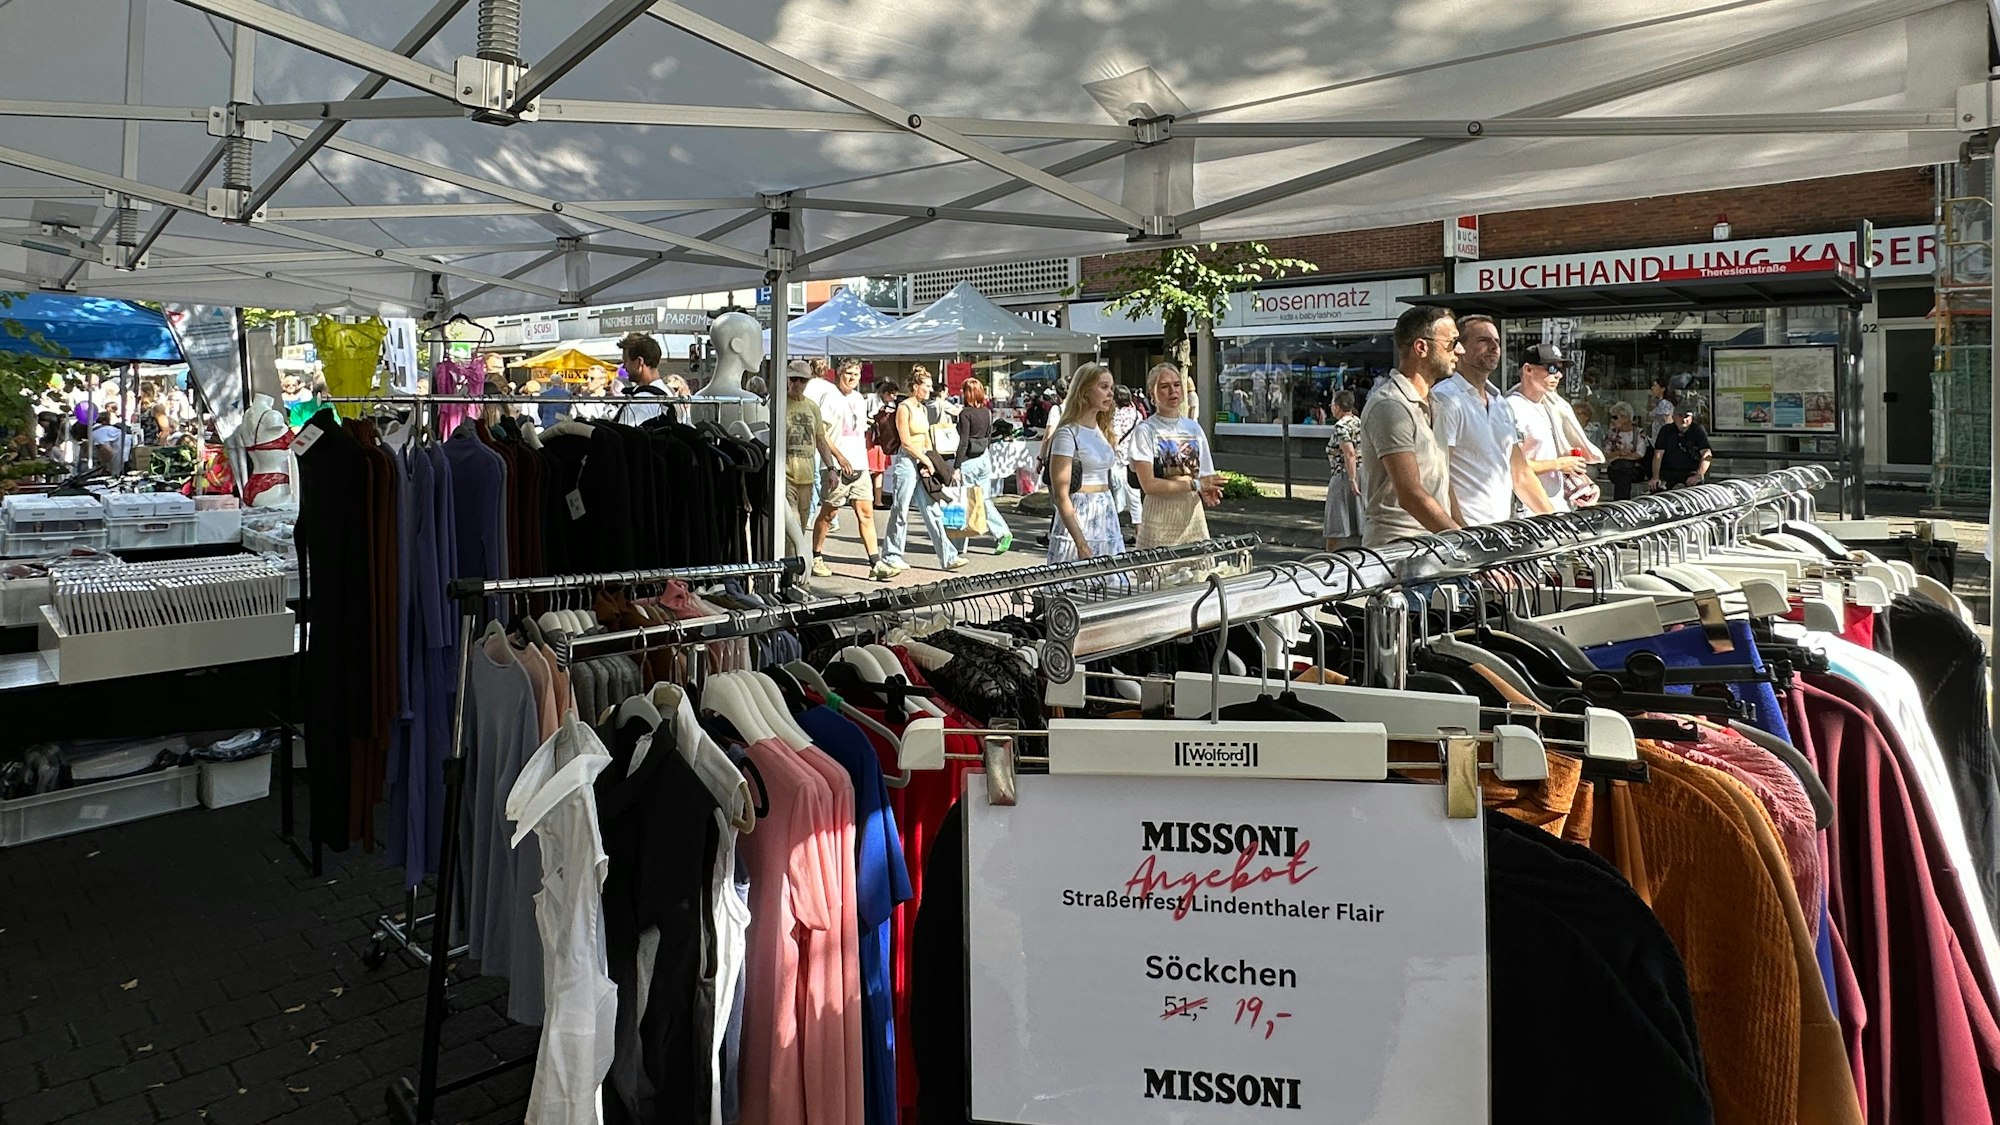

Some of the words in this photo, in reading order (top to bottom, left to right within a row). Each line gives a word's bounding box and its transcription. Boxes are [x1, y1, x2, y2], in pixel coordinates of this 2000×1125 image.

[1457, 229, 1478, 243] BUCH
[1457, 243, 1478, 255] KAISER
[1479, 247, 1770, 291] BUCHHANDLUNG
[1700, 264, 1787, 277] Theresienstraße
[1254, 287, 1370, 312] hosenmatz
[533, 323, 552, 334] SCUSI
[1014, 309, 1057, 328] ILS
[1188, 748, 1244, 761] Wolford
[1142, 821, 1298, 857] MISSONI
[1124, 840, 1319, 921] Angebot
[1062, 889, 1186, 912] Straßenfest
[1191, 896, 1330, 920] Lindenthaler
[1336, 903, 1385, 923] Flair
[1145, 955, 1297, 988] Söckchen
[1234, 996, 1292, 1040] 19,-
[1144, 1068, 1302, 1110] MISSONI
